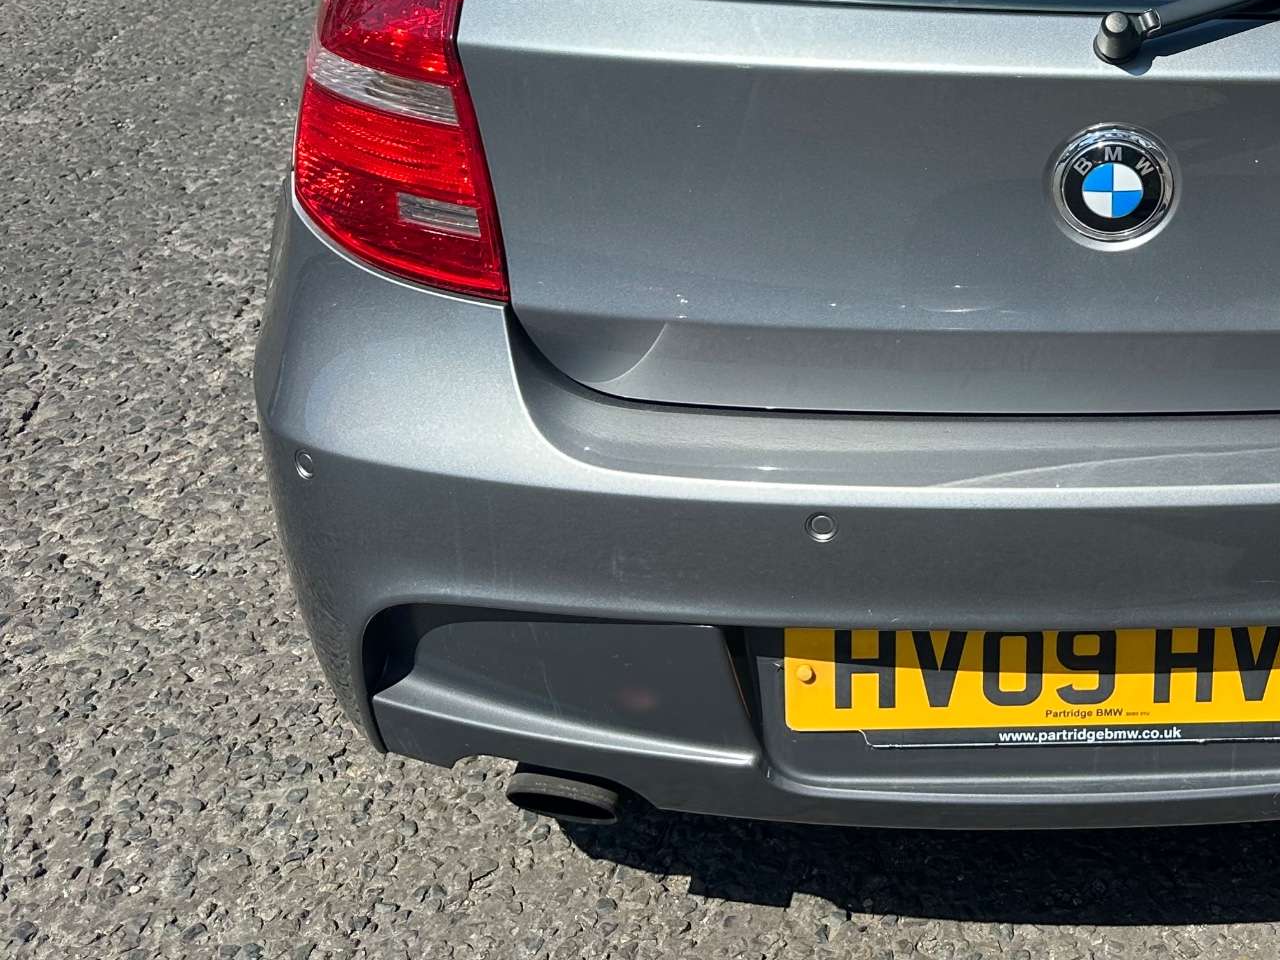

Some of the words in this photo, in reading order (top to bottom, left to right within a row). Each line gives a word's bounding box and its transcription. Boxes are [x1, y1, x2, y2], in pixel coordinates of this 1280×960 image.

[1073, 146, 1155, 177] BMW
[834, 628, 1117, 709] HV09
[1045, 709, 1093, 719] Partridge
[1096, 708, 1124, 717] BMW
[998, 726, 1182, 743] www.partridgebmw.co.uk
